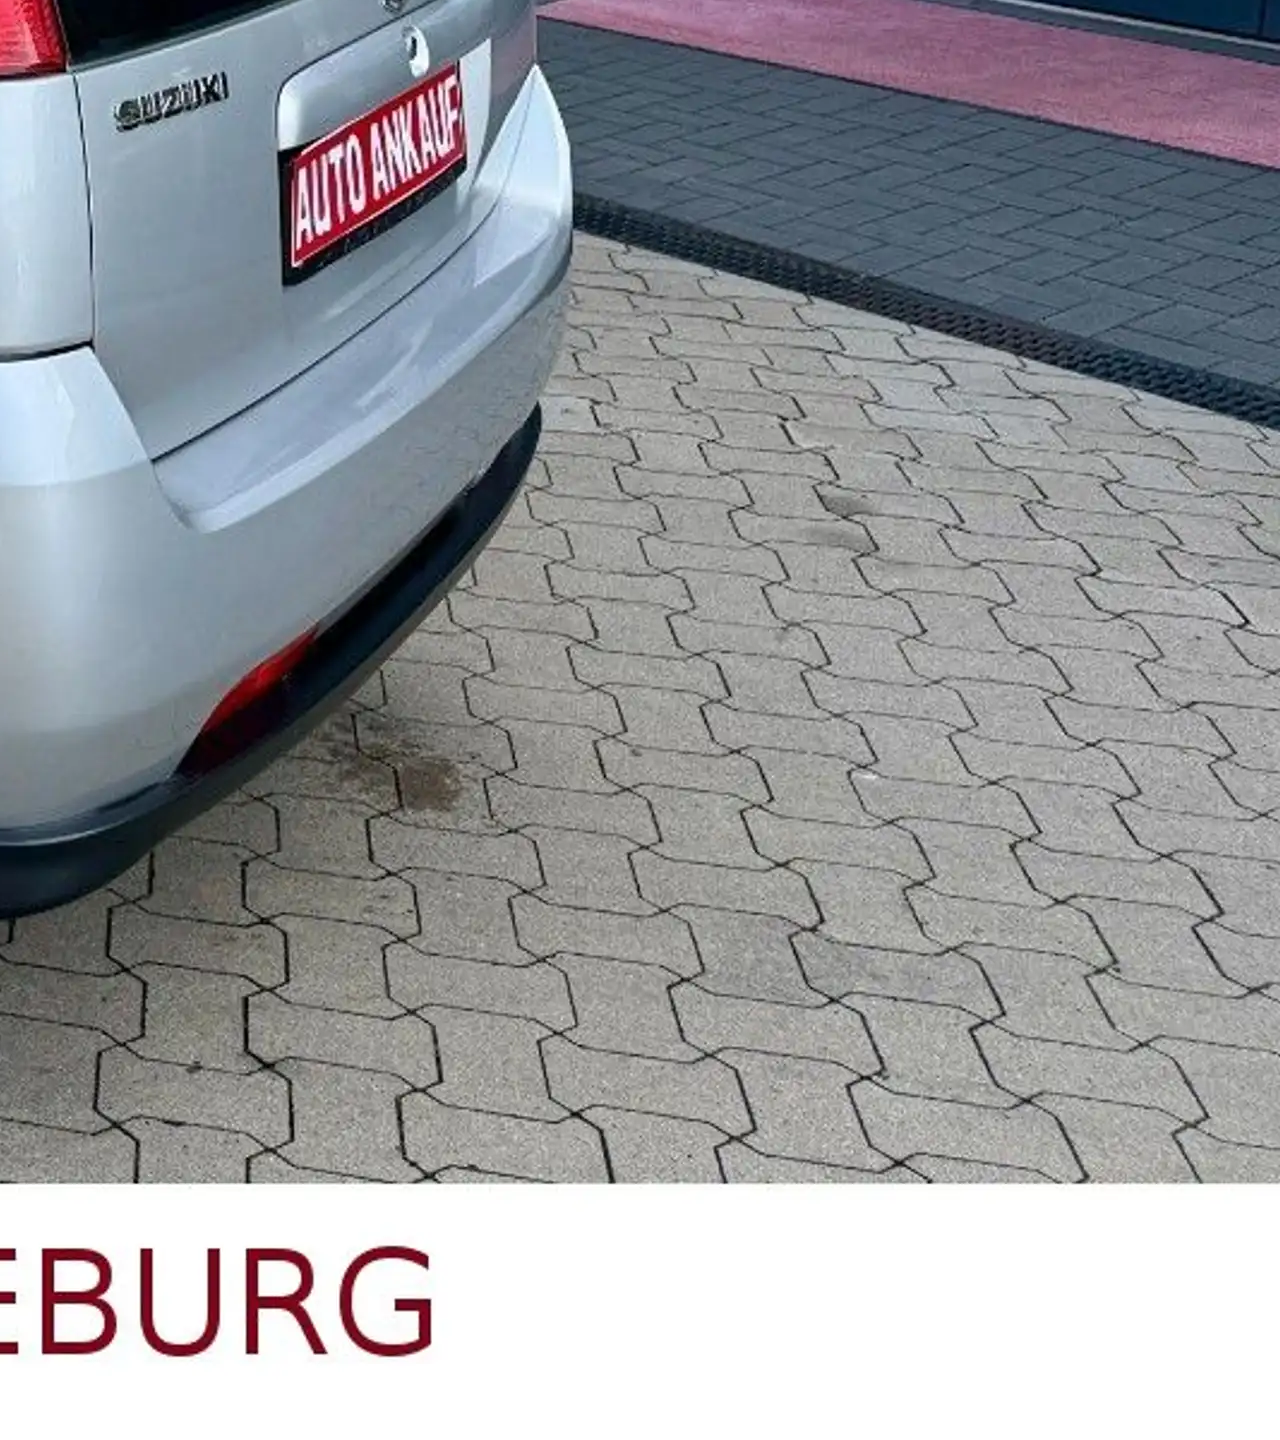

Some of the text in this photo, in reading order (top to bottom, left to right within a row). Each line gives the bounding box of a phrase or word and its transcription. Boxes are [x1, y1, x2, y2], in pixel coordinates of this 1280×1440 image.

[114, 71, 230, 133] SUZUKI
[294, 74, 463, 250] AUTO ANKAUF
